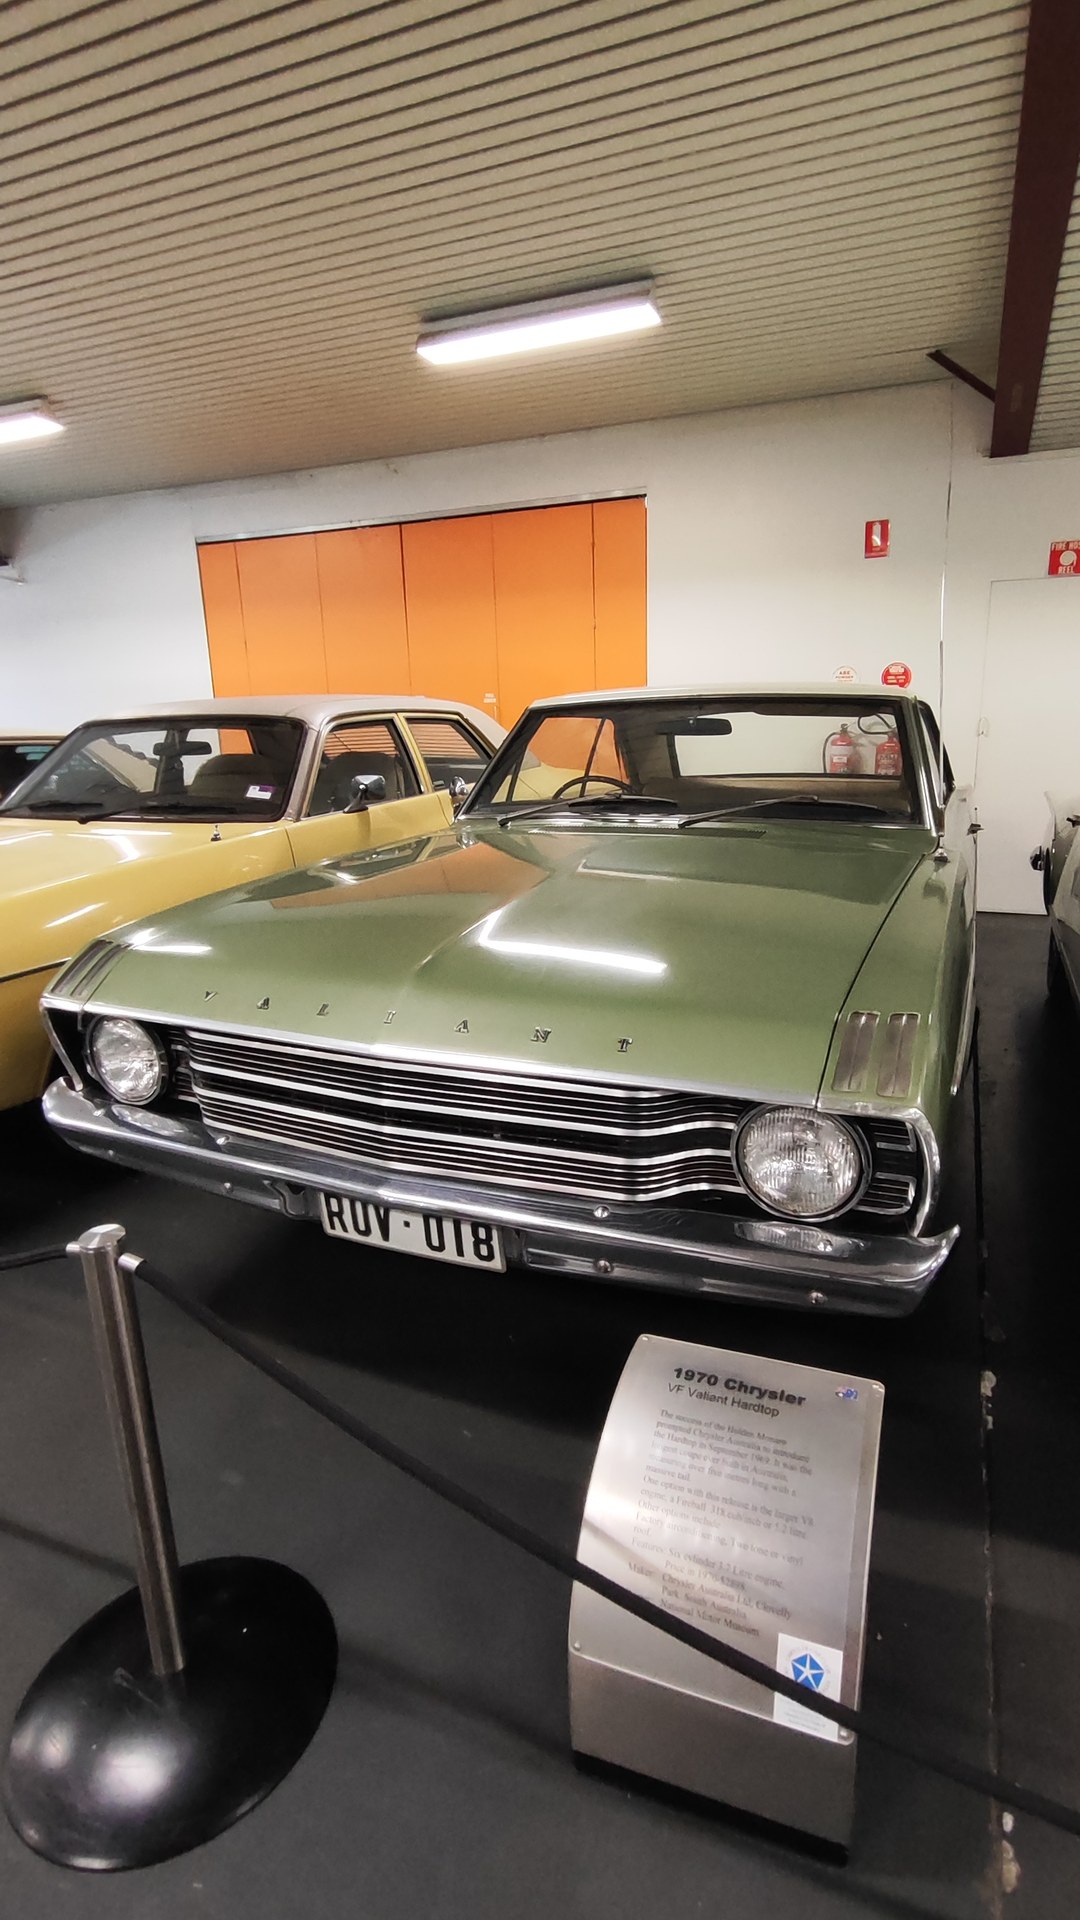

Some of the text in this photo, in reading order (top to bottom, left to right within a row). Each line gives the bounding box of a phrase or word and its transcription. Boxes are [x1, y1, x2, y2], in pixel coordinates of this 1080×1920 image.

[202, 990, 634, 1053] VALIANT
[668, 1382, 780, 1418] VF Valiant Hardtop
[674, 1367, 806, 1406] 1970 Chrysler
